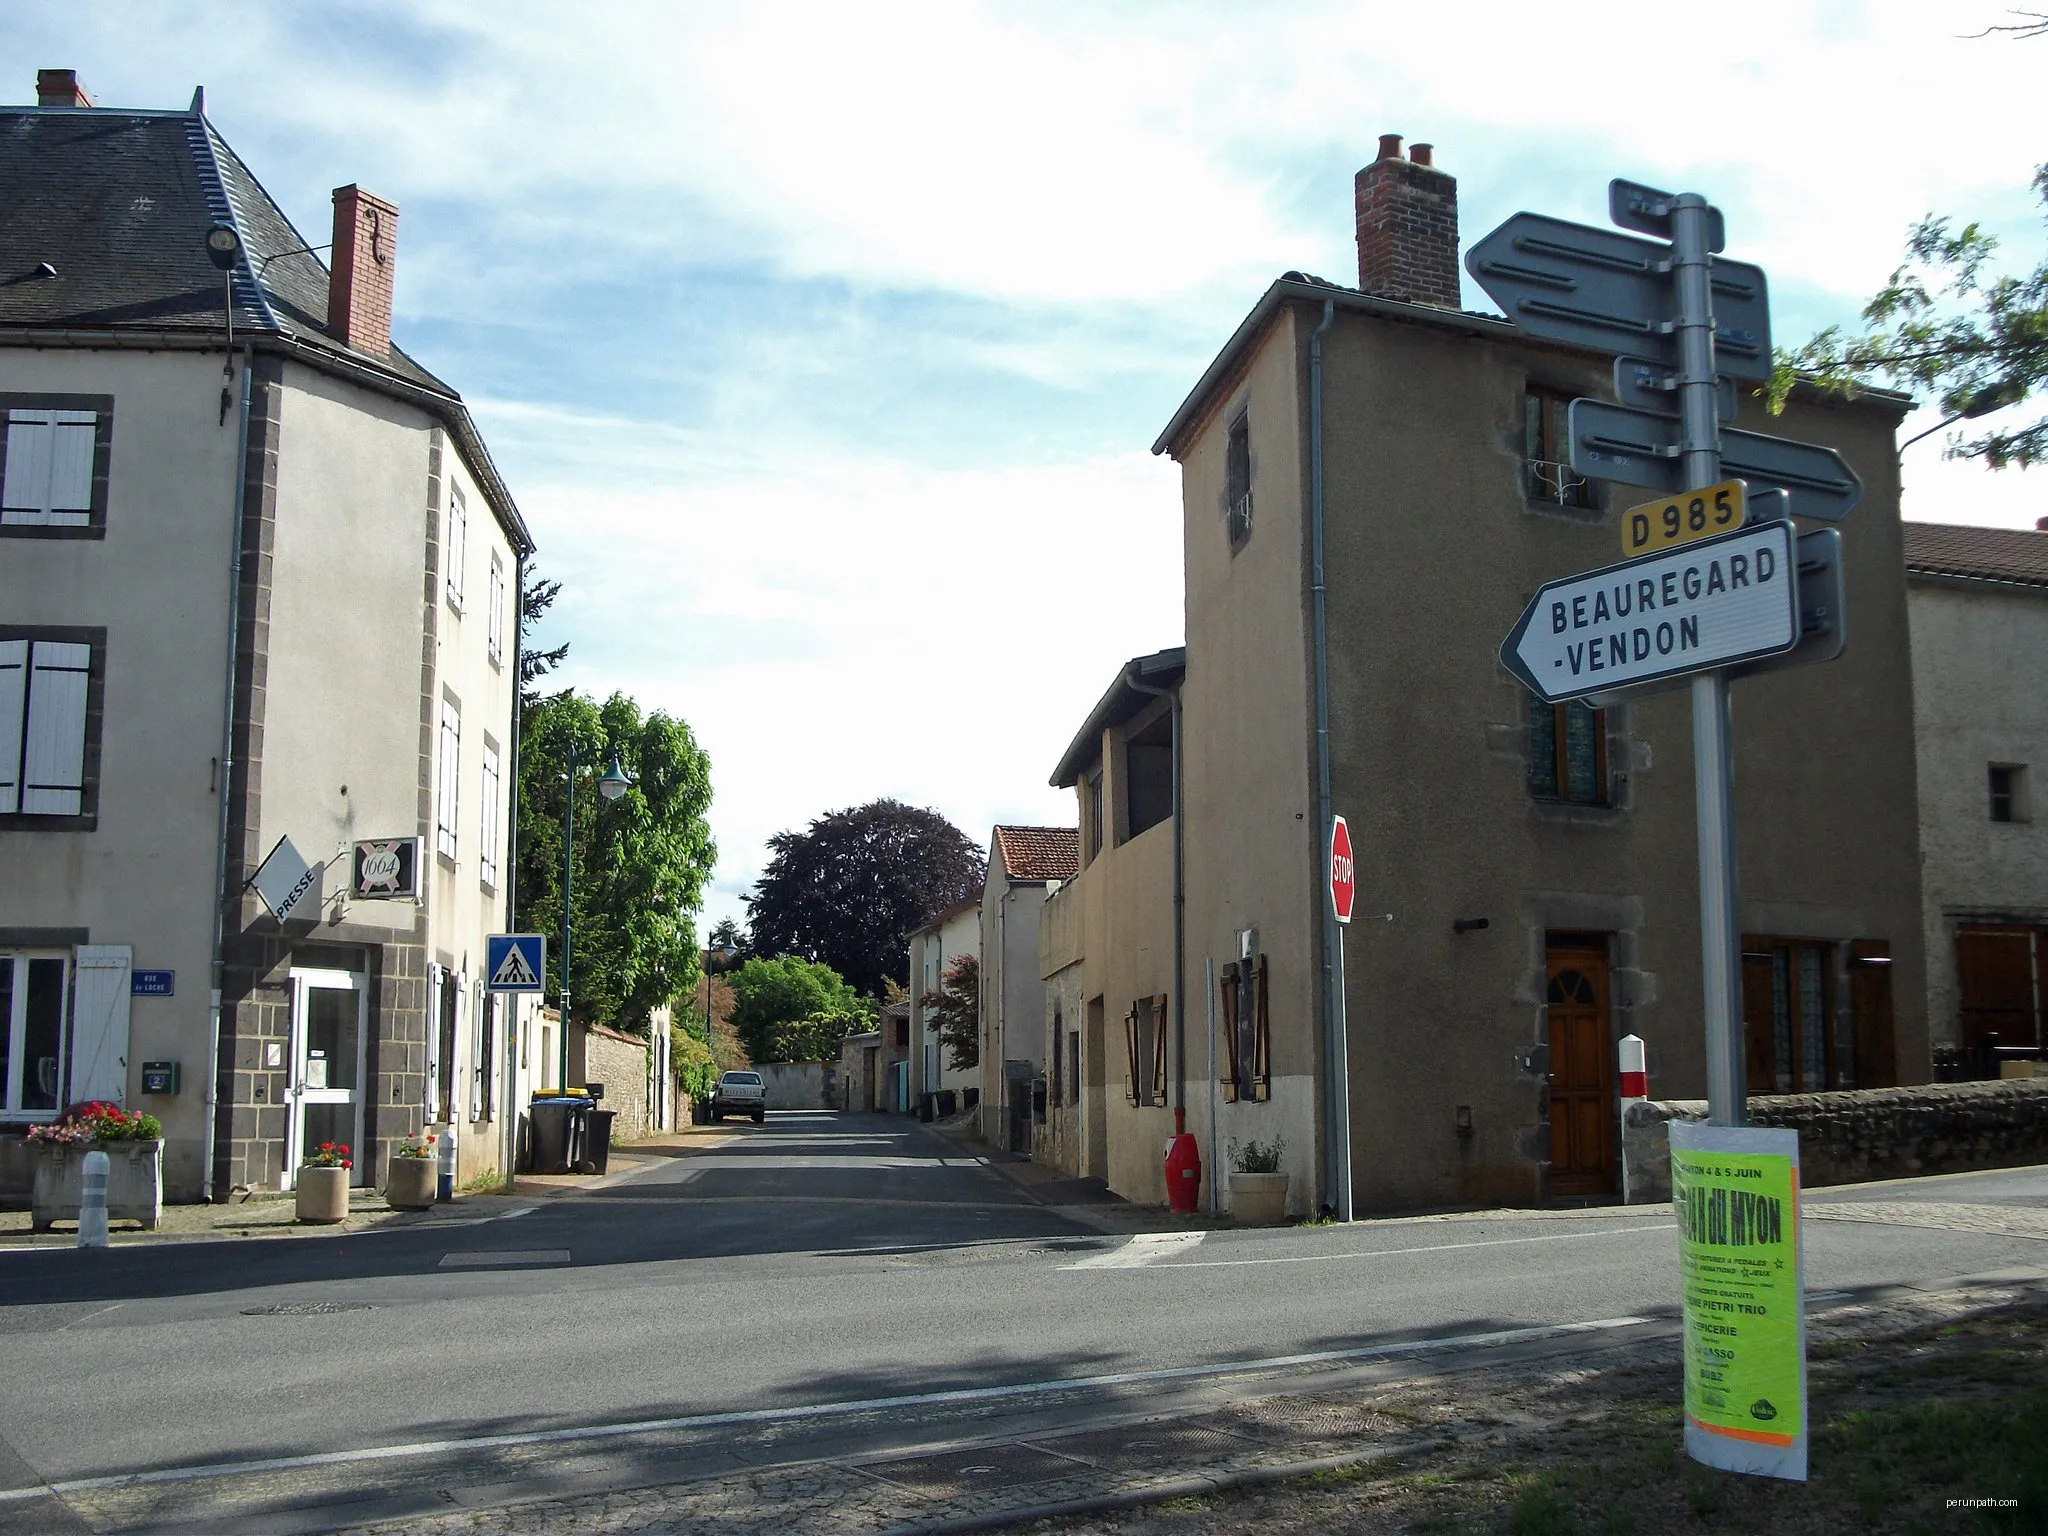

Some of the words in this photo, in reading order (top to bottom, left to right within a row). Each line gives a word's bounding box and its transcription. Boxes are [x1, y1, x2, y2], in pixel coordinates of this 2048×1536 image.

[1632, 514, 1649, 547] D
[1662, 490, 1732, 538] 985
[1552, 547, 1775, 634] BEAUREGARD
[1554, 614, 1699, 675] -VENDON
[364, 857, 397, 875] 1664
[1334, 854, 1351, 883] STOP
[277, 870, 315, 919] PRESSE
[1706, 1167, 1712, 1175] 4
[1715, 1167, 1721, 1177] &
[1725, 1168, 1731, 1177] 5
[1734, 1168, 1762, 1179] JUIN
[1731, 1190, 1781, 1246] MYON
[1749, 1268, 1771, 1277] JEUX
[1703, 1300, 1734, 1313] PIETRI
[1736, 1304, 1767, 1316] TRIO
[1720, 1289, 1755, 1300] GRATUITS
